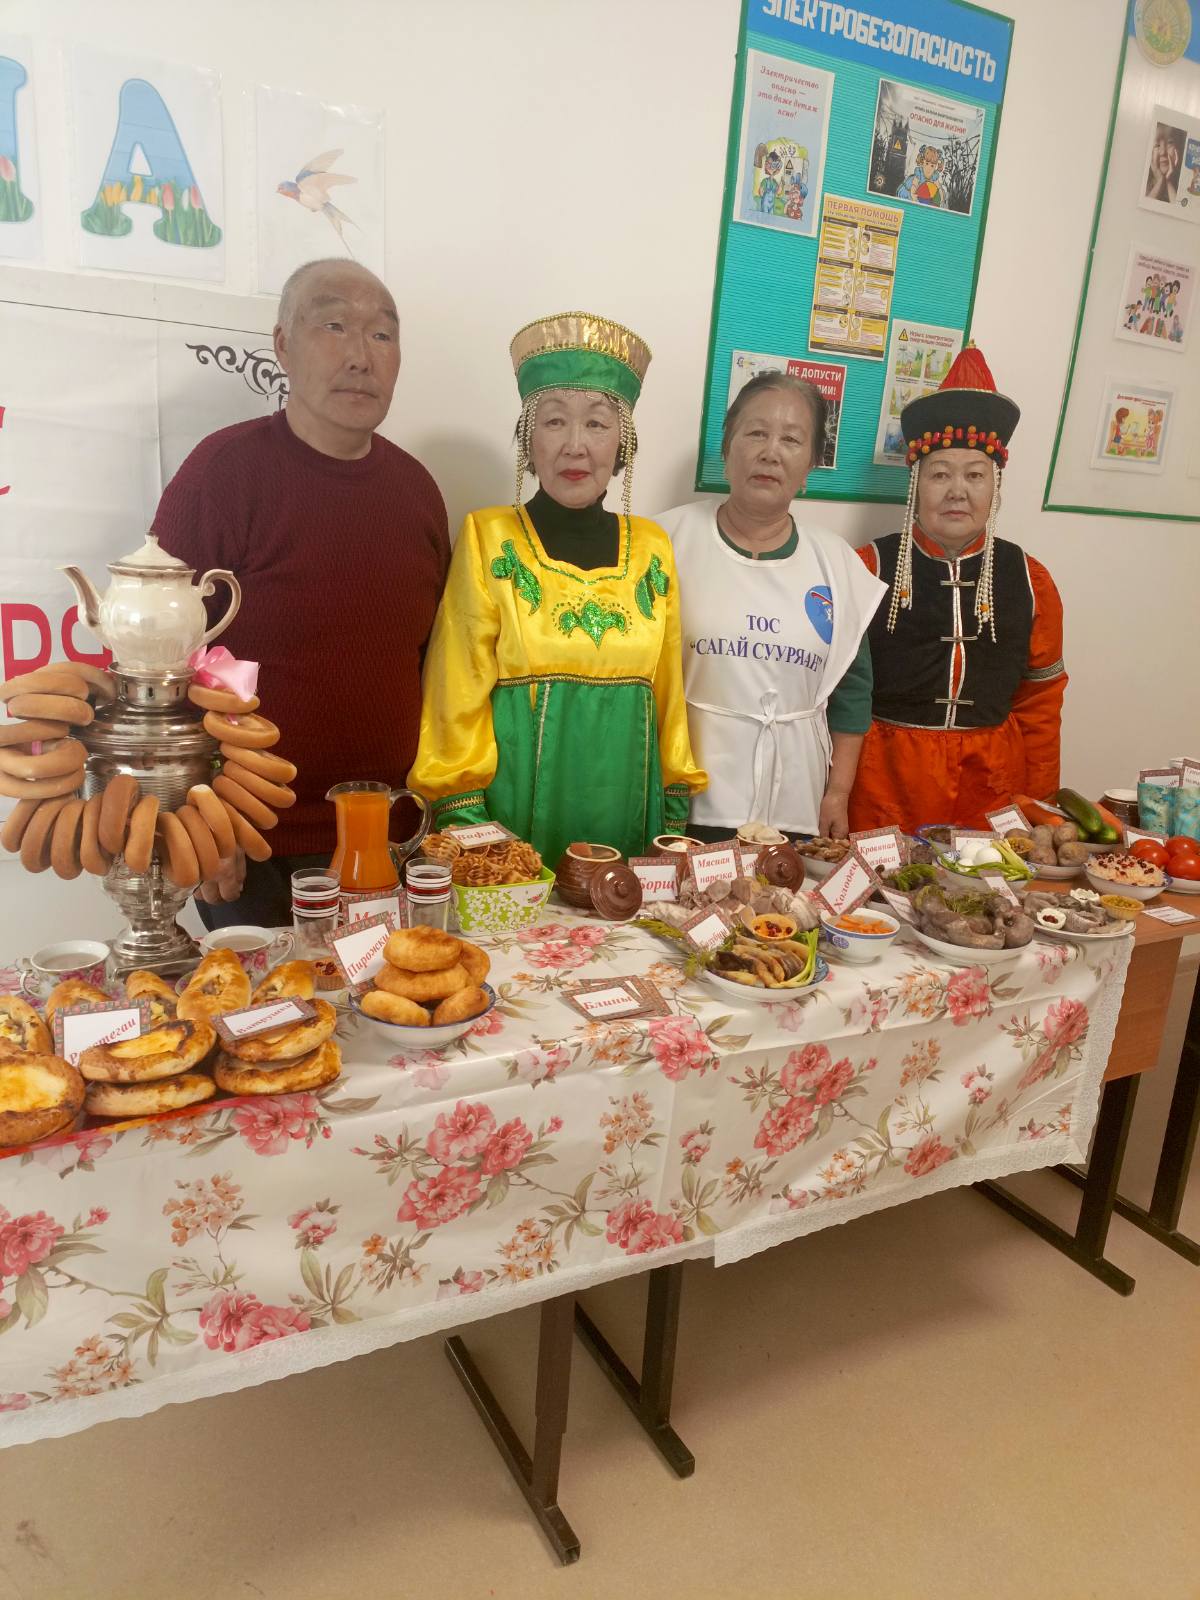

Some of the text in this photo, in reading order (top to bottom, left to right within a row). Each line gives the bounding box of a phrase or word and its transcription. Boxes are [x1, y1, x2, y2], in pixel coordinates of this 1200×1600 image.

[910, 112, 933, 125] ОПАСНО
[933, 119, 945, 128] ДЛЯ
[827, 200, 859, 213] ПЕРВАЯ
[860, 207, 899, 223] ПОМОЩЬ
[788, 365, 842, 382] НЕ ДОПУСТИ
[746, 614, 780, 634] ТОС
[456, 828, 499, 841] Вафли
[860, 841, 896, 854] Кровяная
[698, 857, 730, 869] Мясная
[868, 856, 896, 867] олбаса
[640, 877, 675, 893] Борщ
[834, 862, 858, 907] Холодец
[347, 933, 390, 977] Пирожки
[583, 996, 633, 1010] Блины
[236, 1003, 293, 1034] Ватрушки
[69, 1018, 137, 1065] Ртегаи
